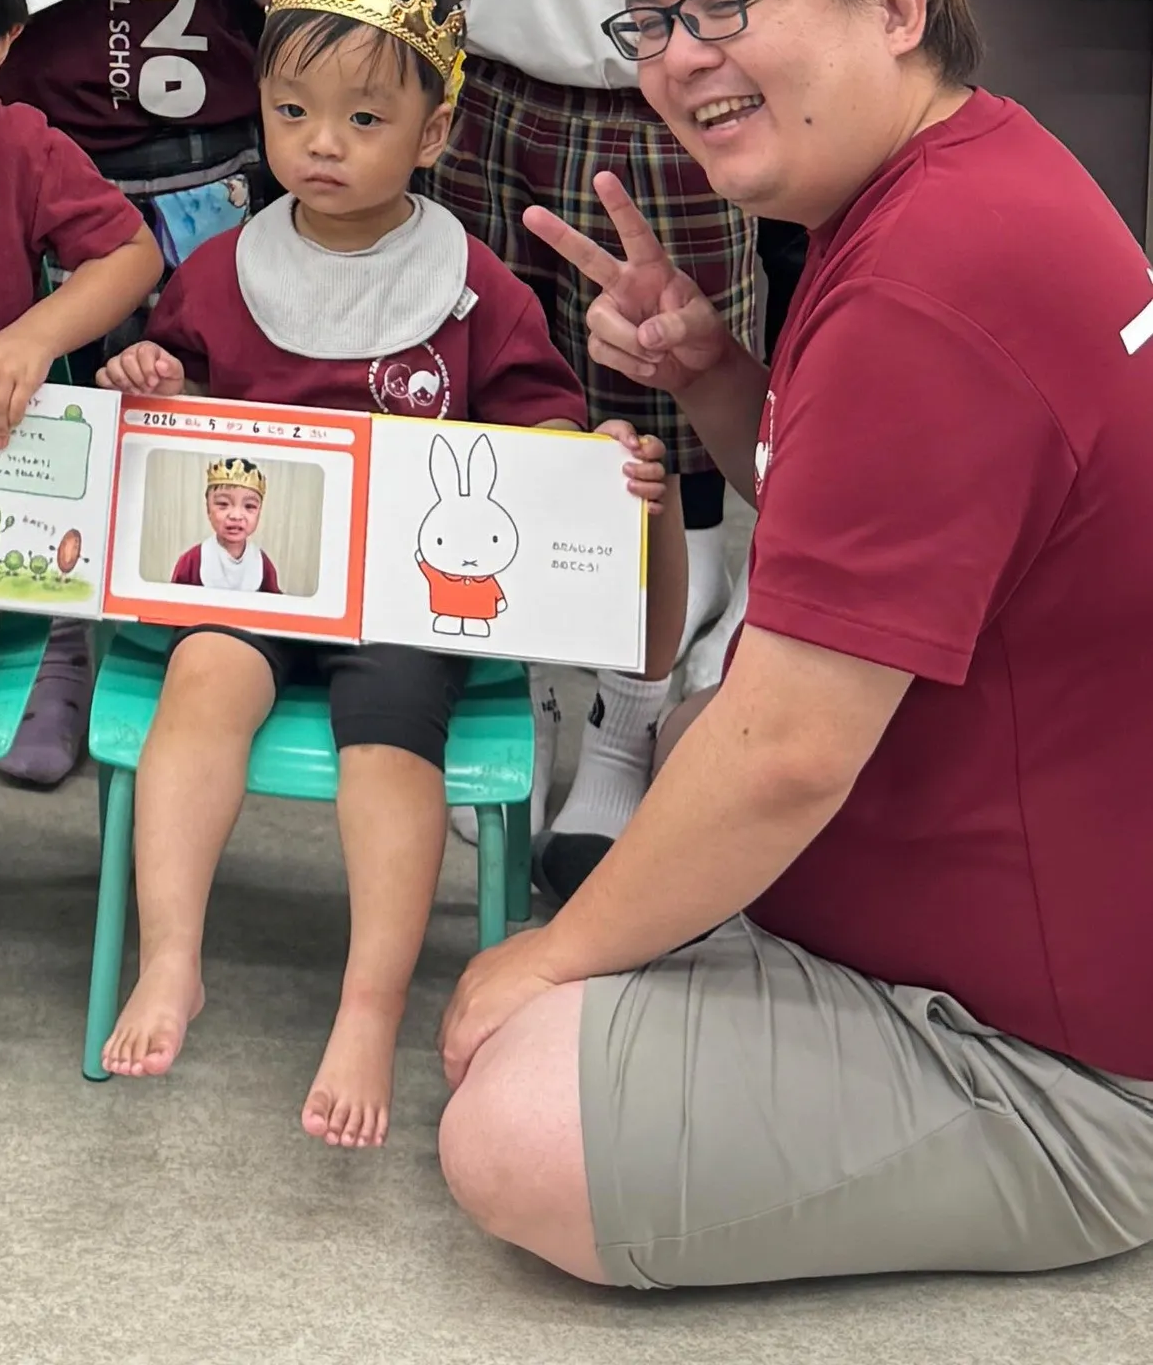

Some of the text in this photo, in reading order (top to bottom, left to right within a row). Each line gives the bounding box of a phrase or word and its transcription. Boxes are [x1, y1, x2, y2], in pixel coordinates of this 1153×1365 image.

[143, 413, 176, 426] 2026
[208, 418, 216, 431] 5
[252, 422, 260, 434] 6
[292, 427, 301, 438] 2
